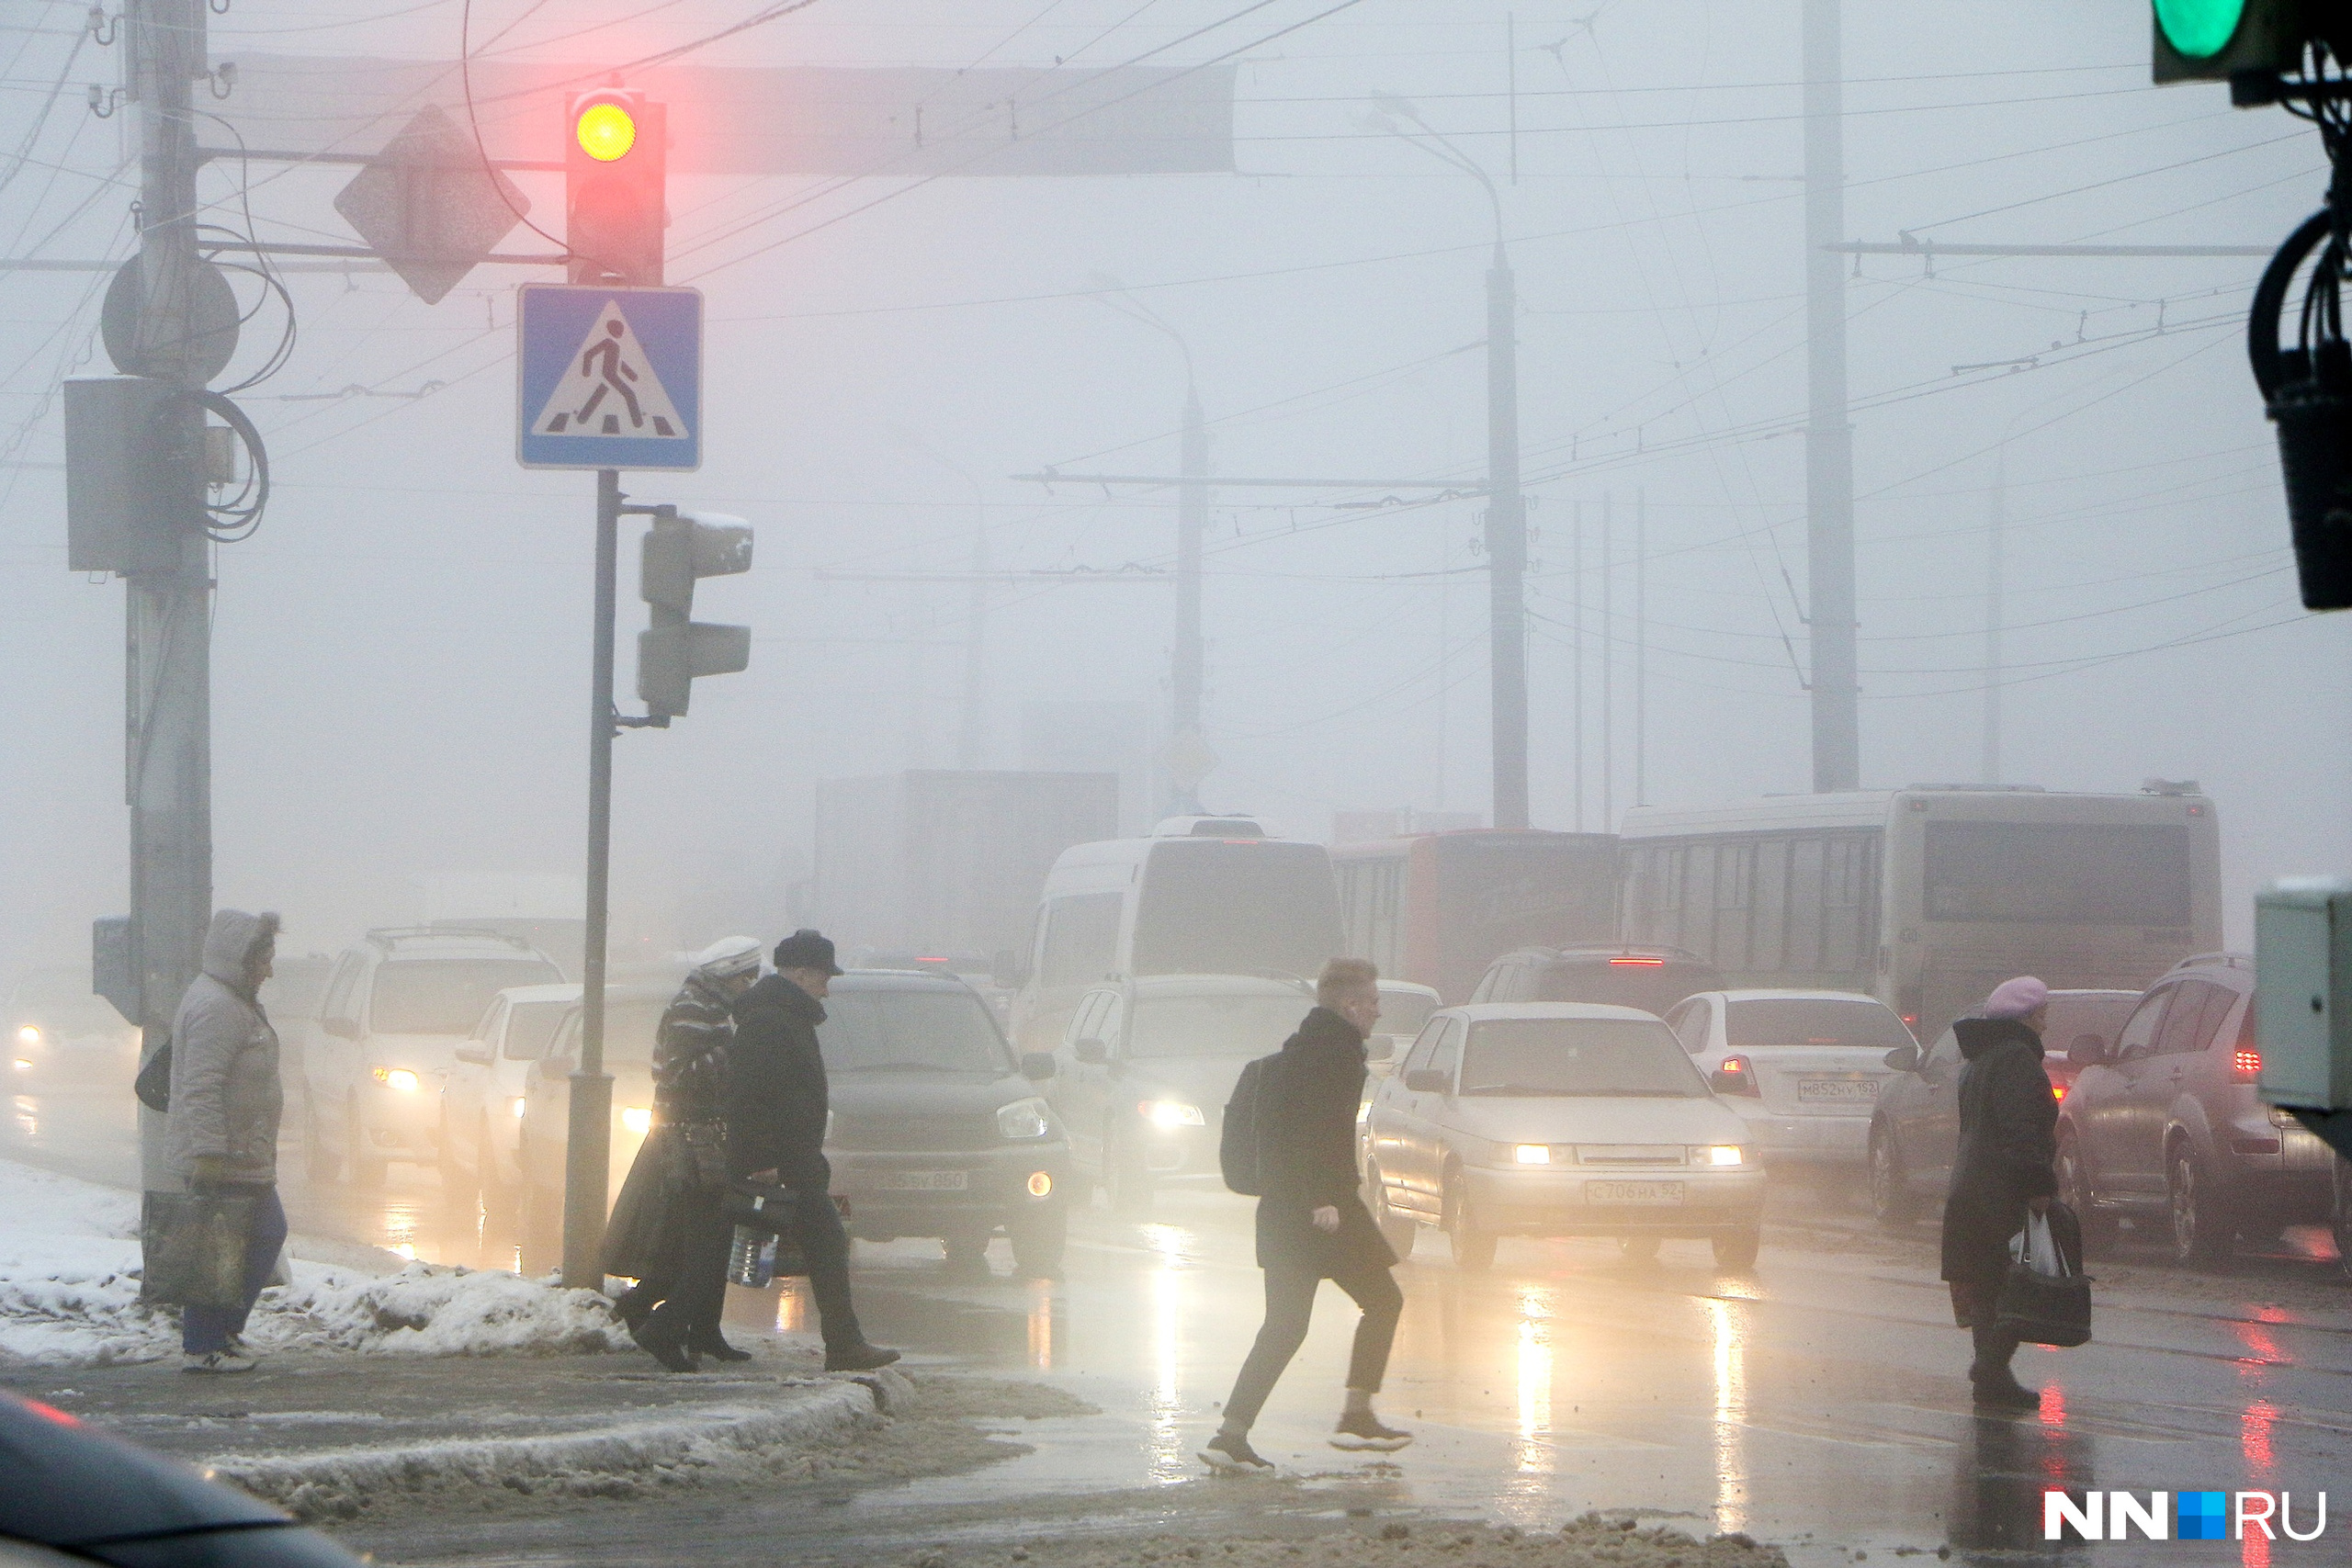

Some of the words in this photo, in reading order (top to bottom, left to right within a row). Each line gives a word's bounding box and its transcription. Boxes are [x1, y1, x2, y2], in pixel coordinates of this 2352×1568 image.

[1857, 1082, 1877, 1093] 152
[933, 1172, 963, 1188] 850
[1661, 1182, 1678, 1195] 52
